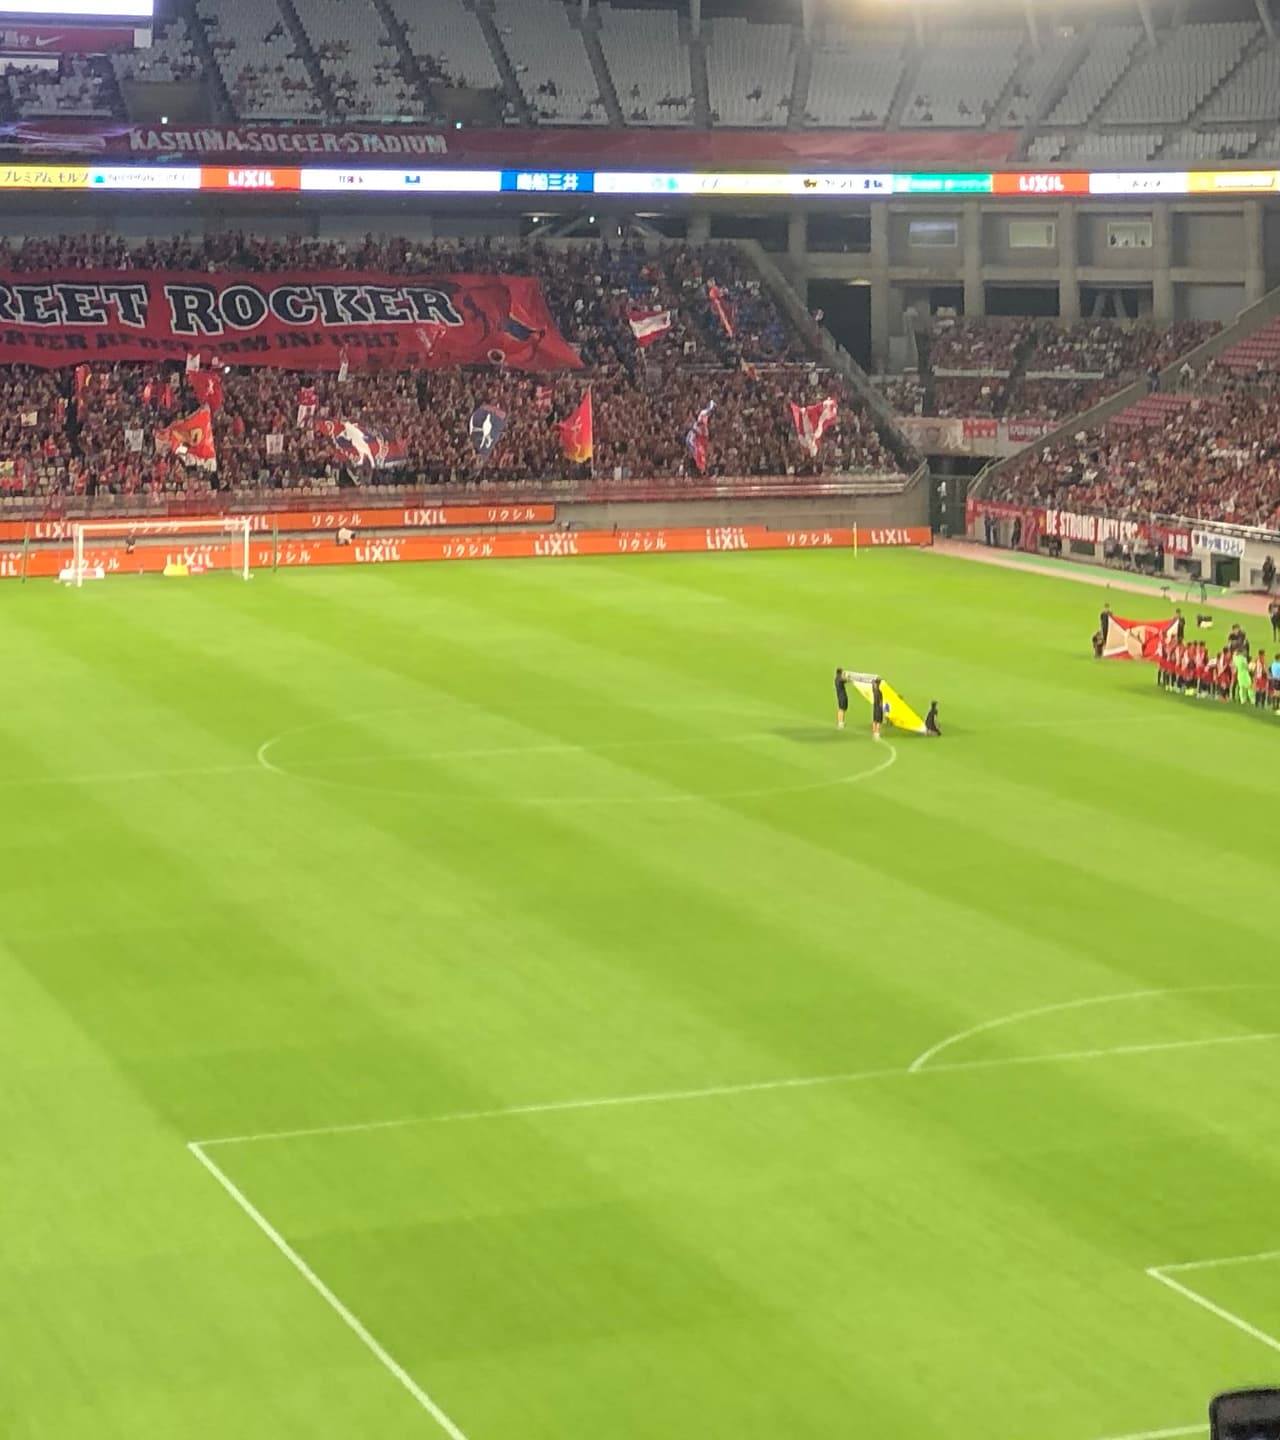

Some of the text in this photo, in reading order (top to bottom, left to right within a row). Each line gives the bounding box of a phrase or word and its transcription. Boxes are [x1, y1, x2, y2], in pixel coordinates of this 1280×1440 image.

[130, 128, 449, 156] KASHIMA SOCCER STADIUM
[228, 169, 275, 187] LIXIL
[1019, 174, 1064, 191] LIXIL
[164, 283, 464, 336] ROCKER
[224, 515, 270, 531] LIXIL
[311, 512, 363, 527] リクシル
[404, 508, 447, 525] LIXIL
[487, 507, 536, 522] リクシル
[1059, 511, 1096, 543] STRONG
[617, 535, 667, 552] リクシル
[706, 531, 749, 549] LIXIL
[786, 531, 833, 545] リクシル
[871, 528, 912, 545] LIXIL
[354, 543, 401, 562] LIXIL
[442, 541, 494, 558] リクシル
[534, 536, 579, 556] LIXIL
[258, 549, 312, 565] リクシル
